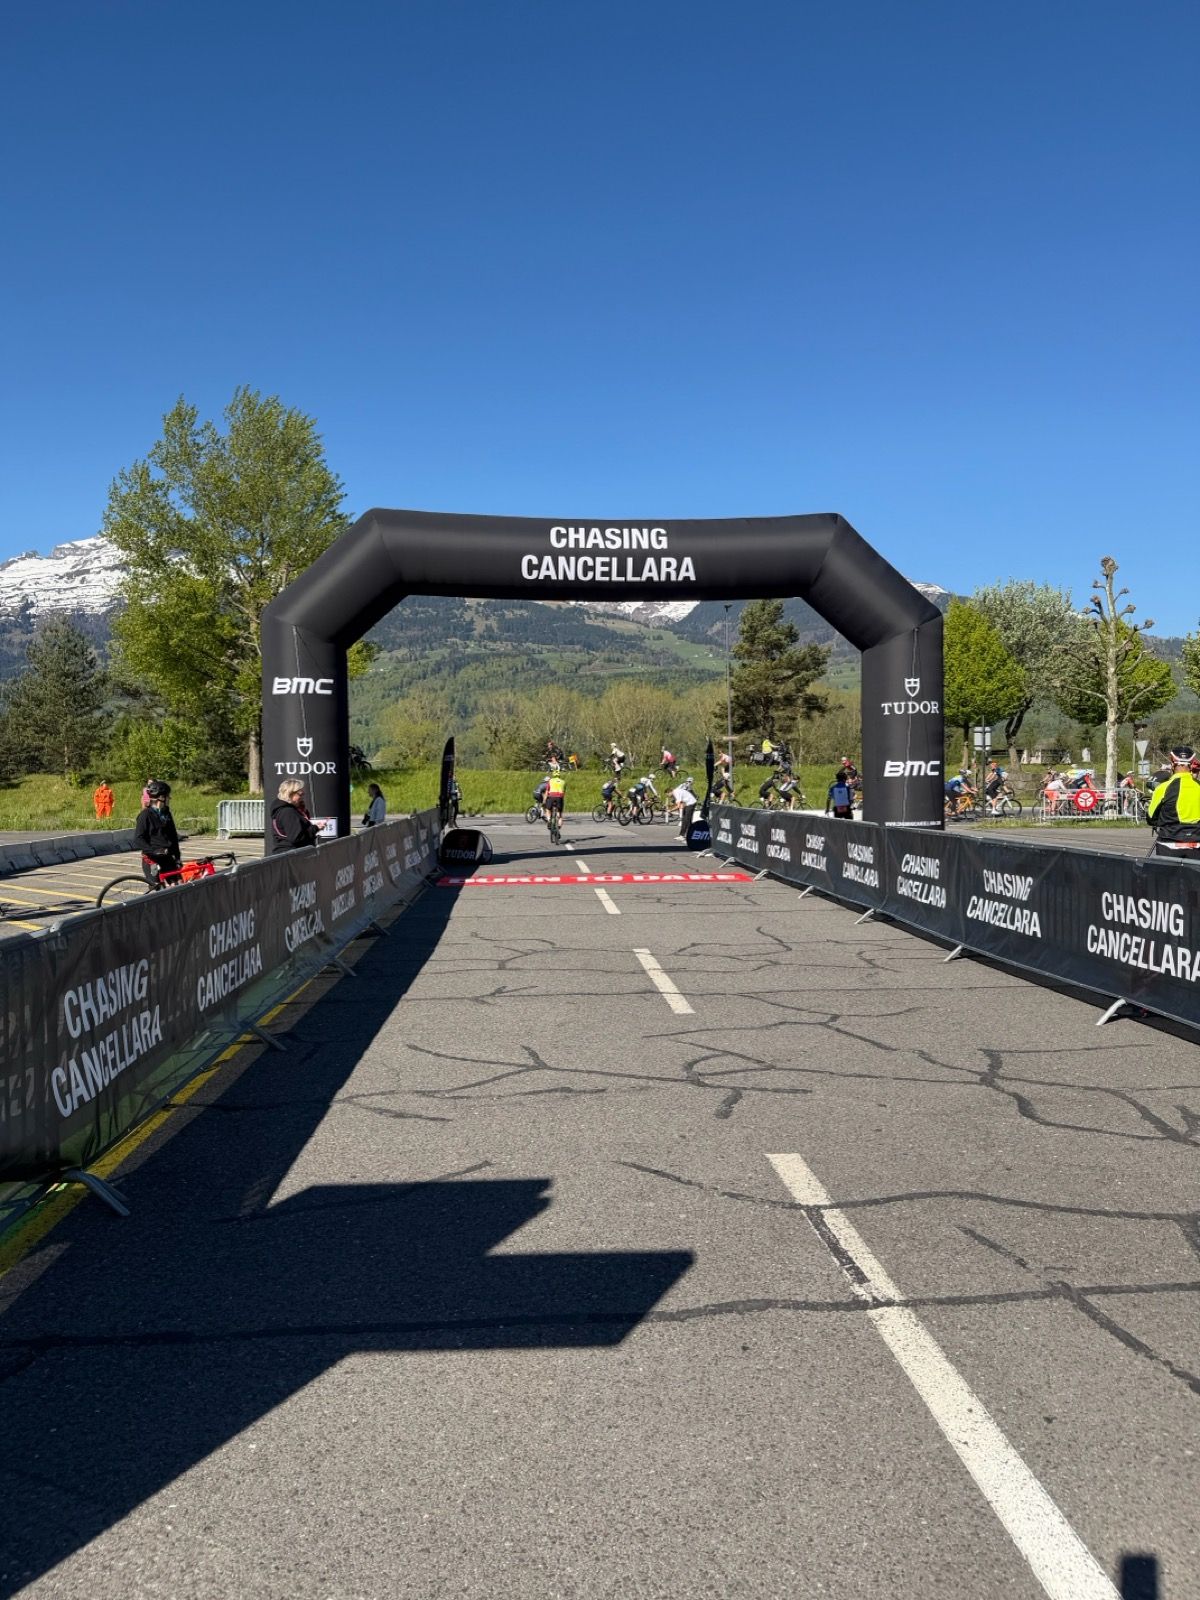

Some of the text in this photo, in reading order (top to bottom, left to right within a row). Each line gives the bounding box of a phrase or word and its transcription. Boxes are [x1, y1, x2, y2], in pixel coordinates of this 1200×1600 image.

[550, 526, 668, 549] CHASING
[521, 555, 697, 582] CANCELLARA
[272, 677, 334, 695] BMC
[881, 701, 939, 715] TUDOR
[274, 761, 337, 775] TUDOR
[883, 760, 940, 777] BMC
[691, 830, 711, 840] BM
[444, 849, 476, 860] TUDOR
[901, 853, 940, 879] CHASING
[632, 874, 736, 882] DARE
[983, 869, 1034, 901] CHASING
[966, 895, 1042, 938] CANCELLARA
[1101, 891, 1184, 937] CHASING
[197, 943, 263, 1012] CANCELLARA
[64, 958, 149, 1039] CHASING
[51, 1004, 163, 1118] CANCELLARA
